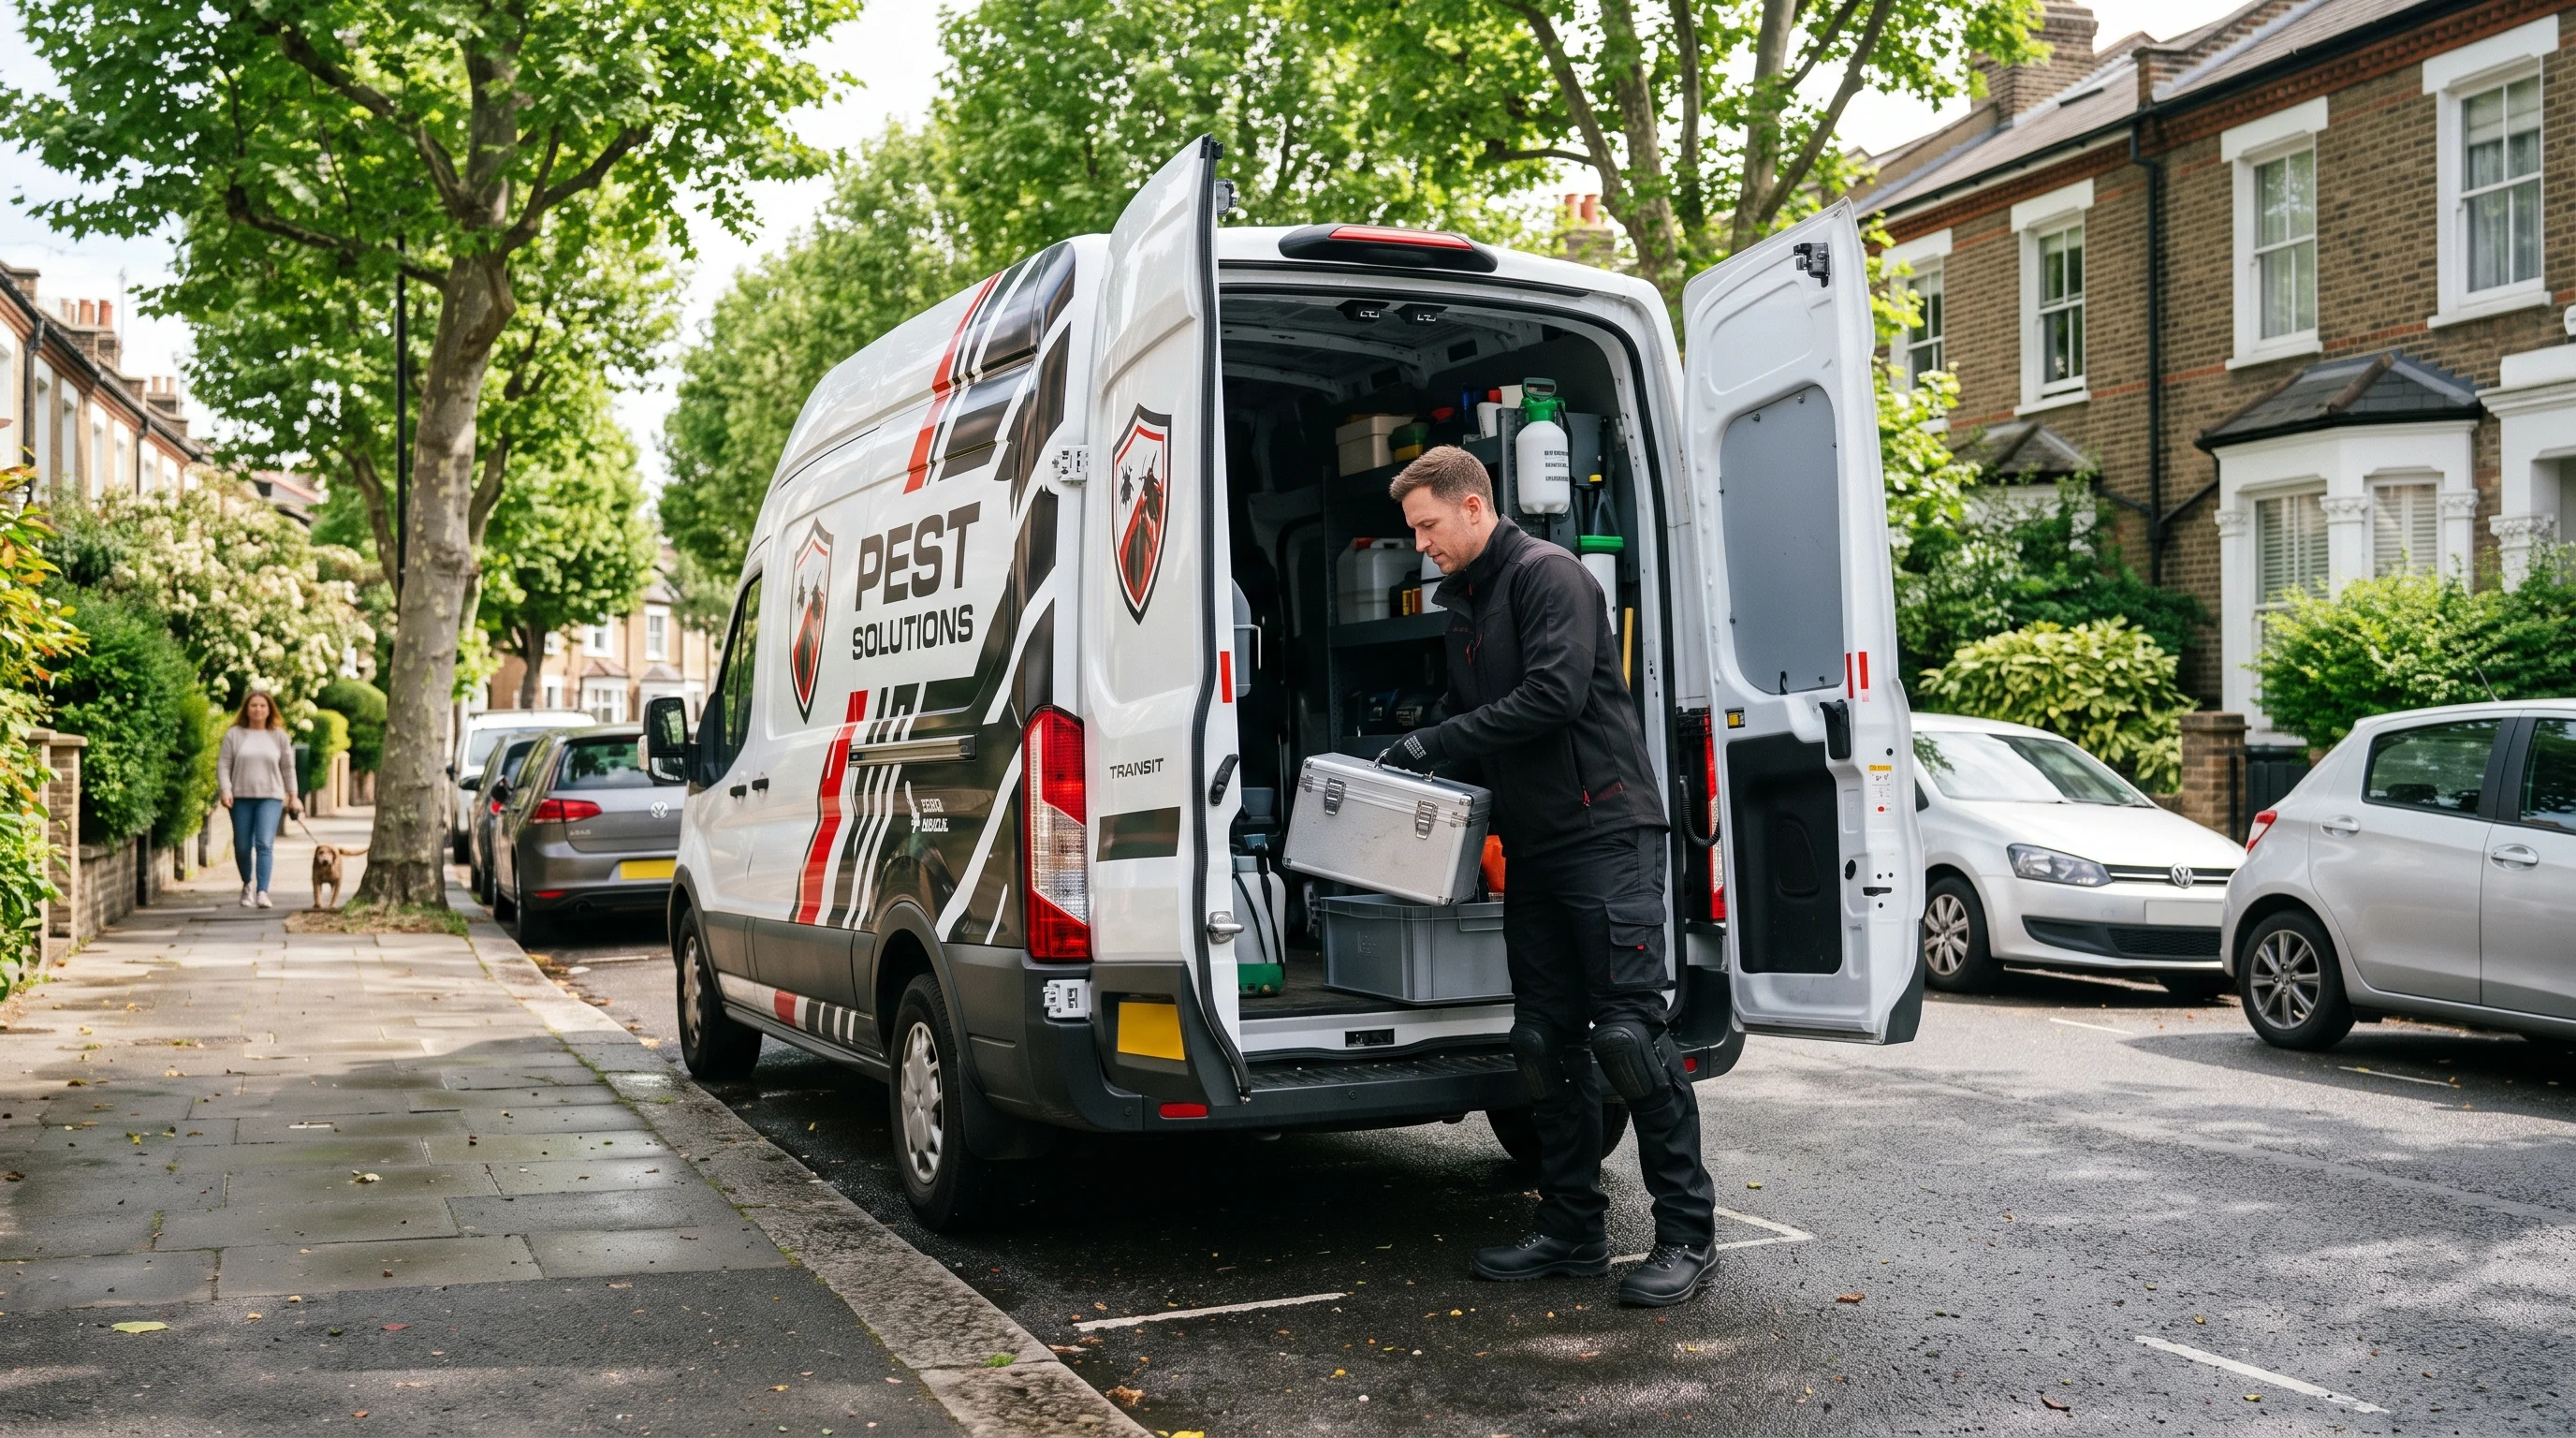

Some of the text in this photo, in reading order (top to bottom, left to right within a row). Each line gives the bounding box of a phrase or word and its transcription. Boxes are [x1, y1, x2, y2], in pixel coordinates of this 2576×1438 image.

[855, 501, 981, 612] PEST
[852, 604, 973, 660] SOLUTIONS
[1109, 757, 1164, 779] TRANSIT
